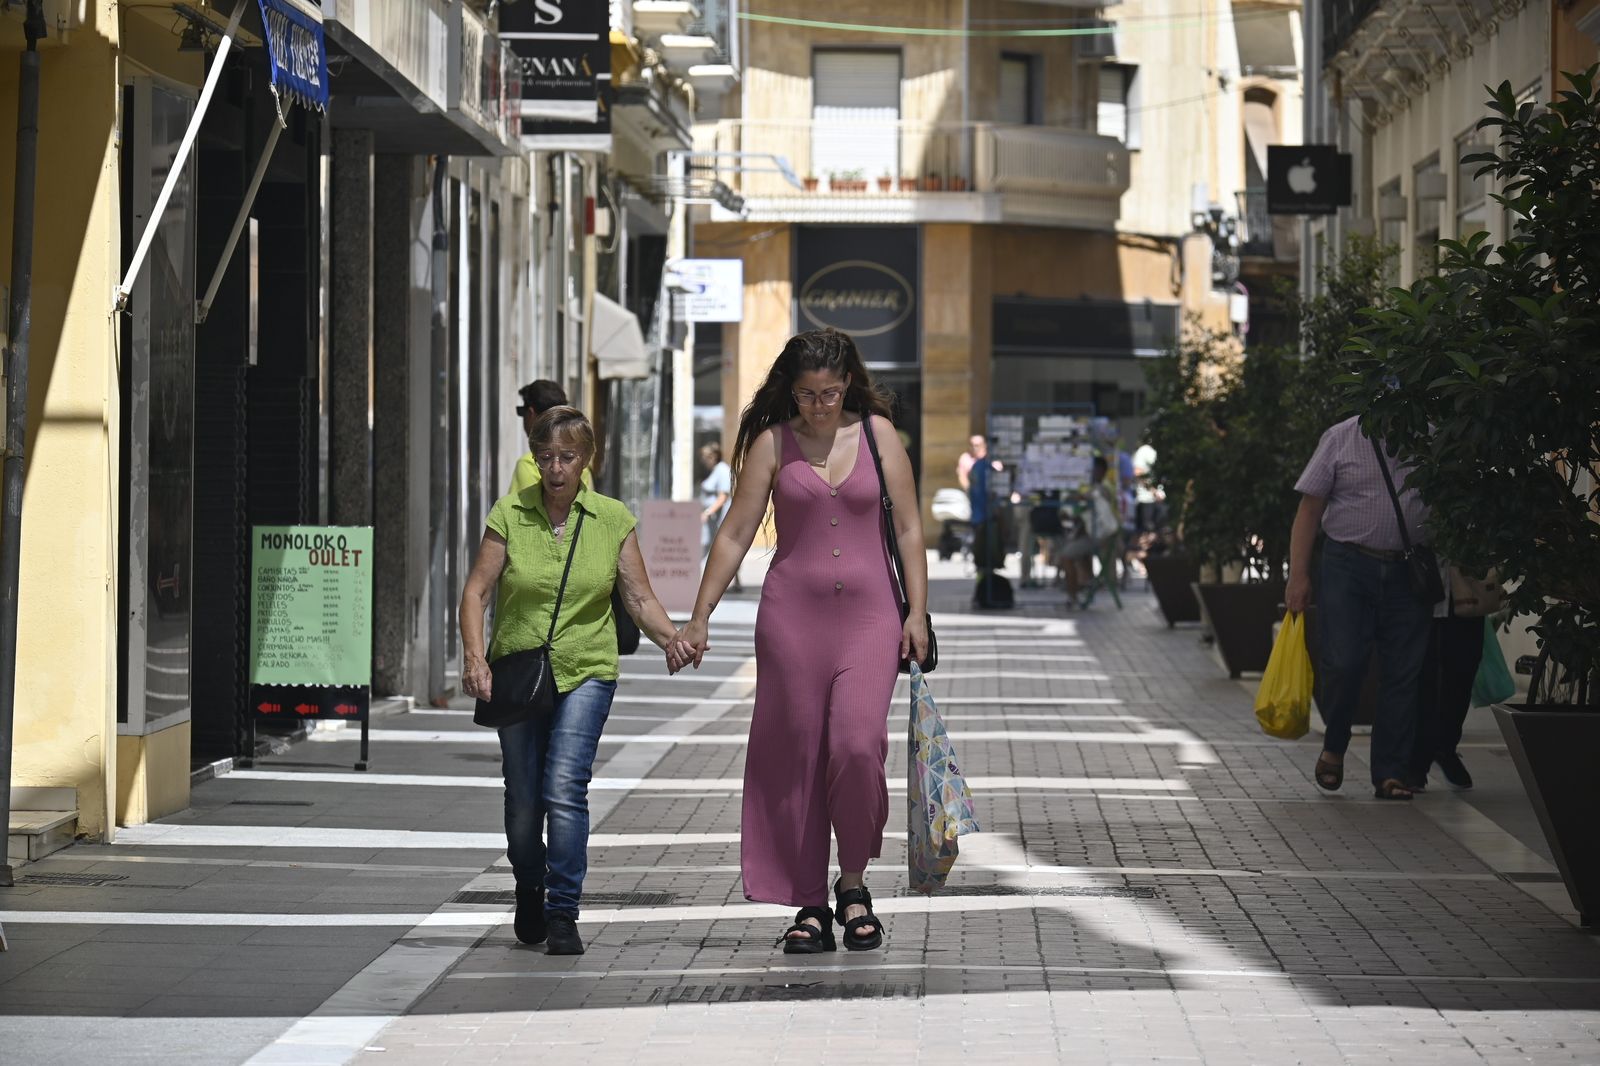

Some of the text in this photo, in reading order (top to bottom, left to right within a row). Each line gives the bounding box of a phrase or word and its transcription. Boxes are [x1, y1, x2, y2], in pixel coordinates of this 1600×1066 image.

[534, 0, 563, 25] S
[261, 533, 347, 551] MONOLOKO
[308, 549, 362, 567] OULET
[258, 567, 297, 575] CAMISETAS
[257, 593, 294, 601] VESTIDOS
[271, 635, 277, 643] Y
